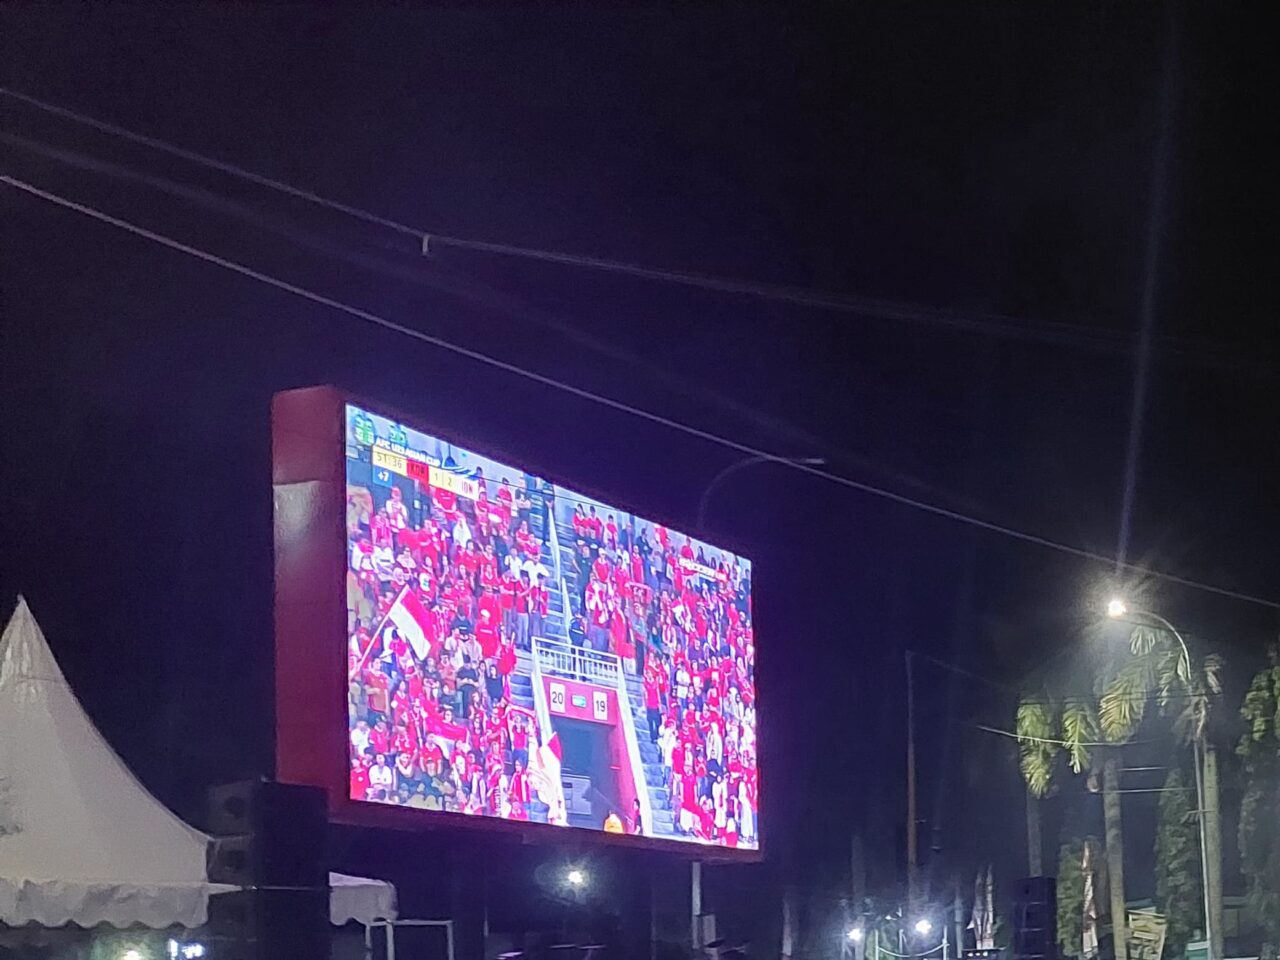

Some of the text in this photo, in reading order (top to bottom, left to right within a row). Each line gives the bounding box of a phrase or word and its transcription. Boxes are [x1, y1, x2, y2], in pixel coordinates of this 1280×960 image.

[375, 437, 391, 449] AFC
[552, 691, 564, 705] 20
[596, 699, 606, 713] 19
